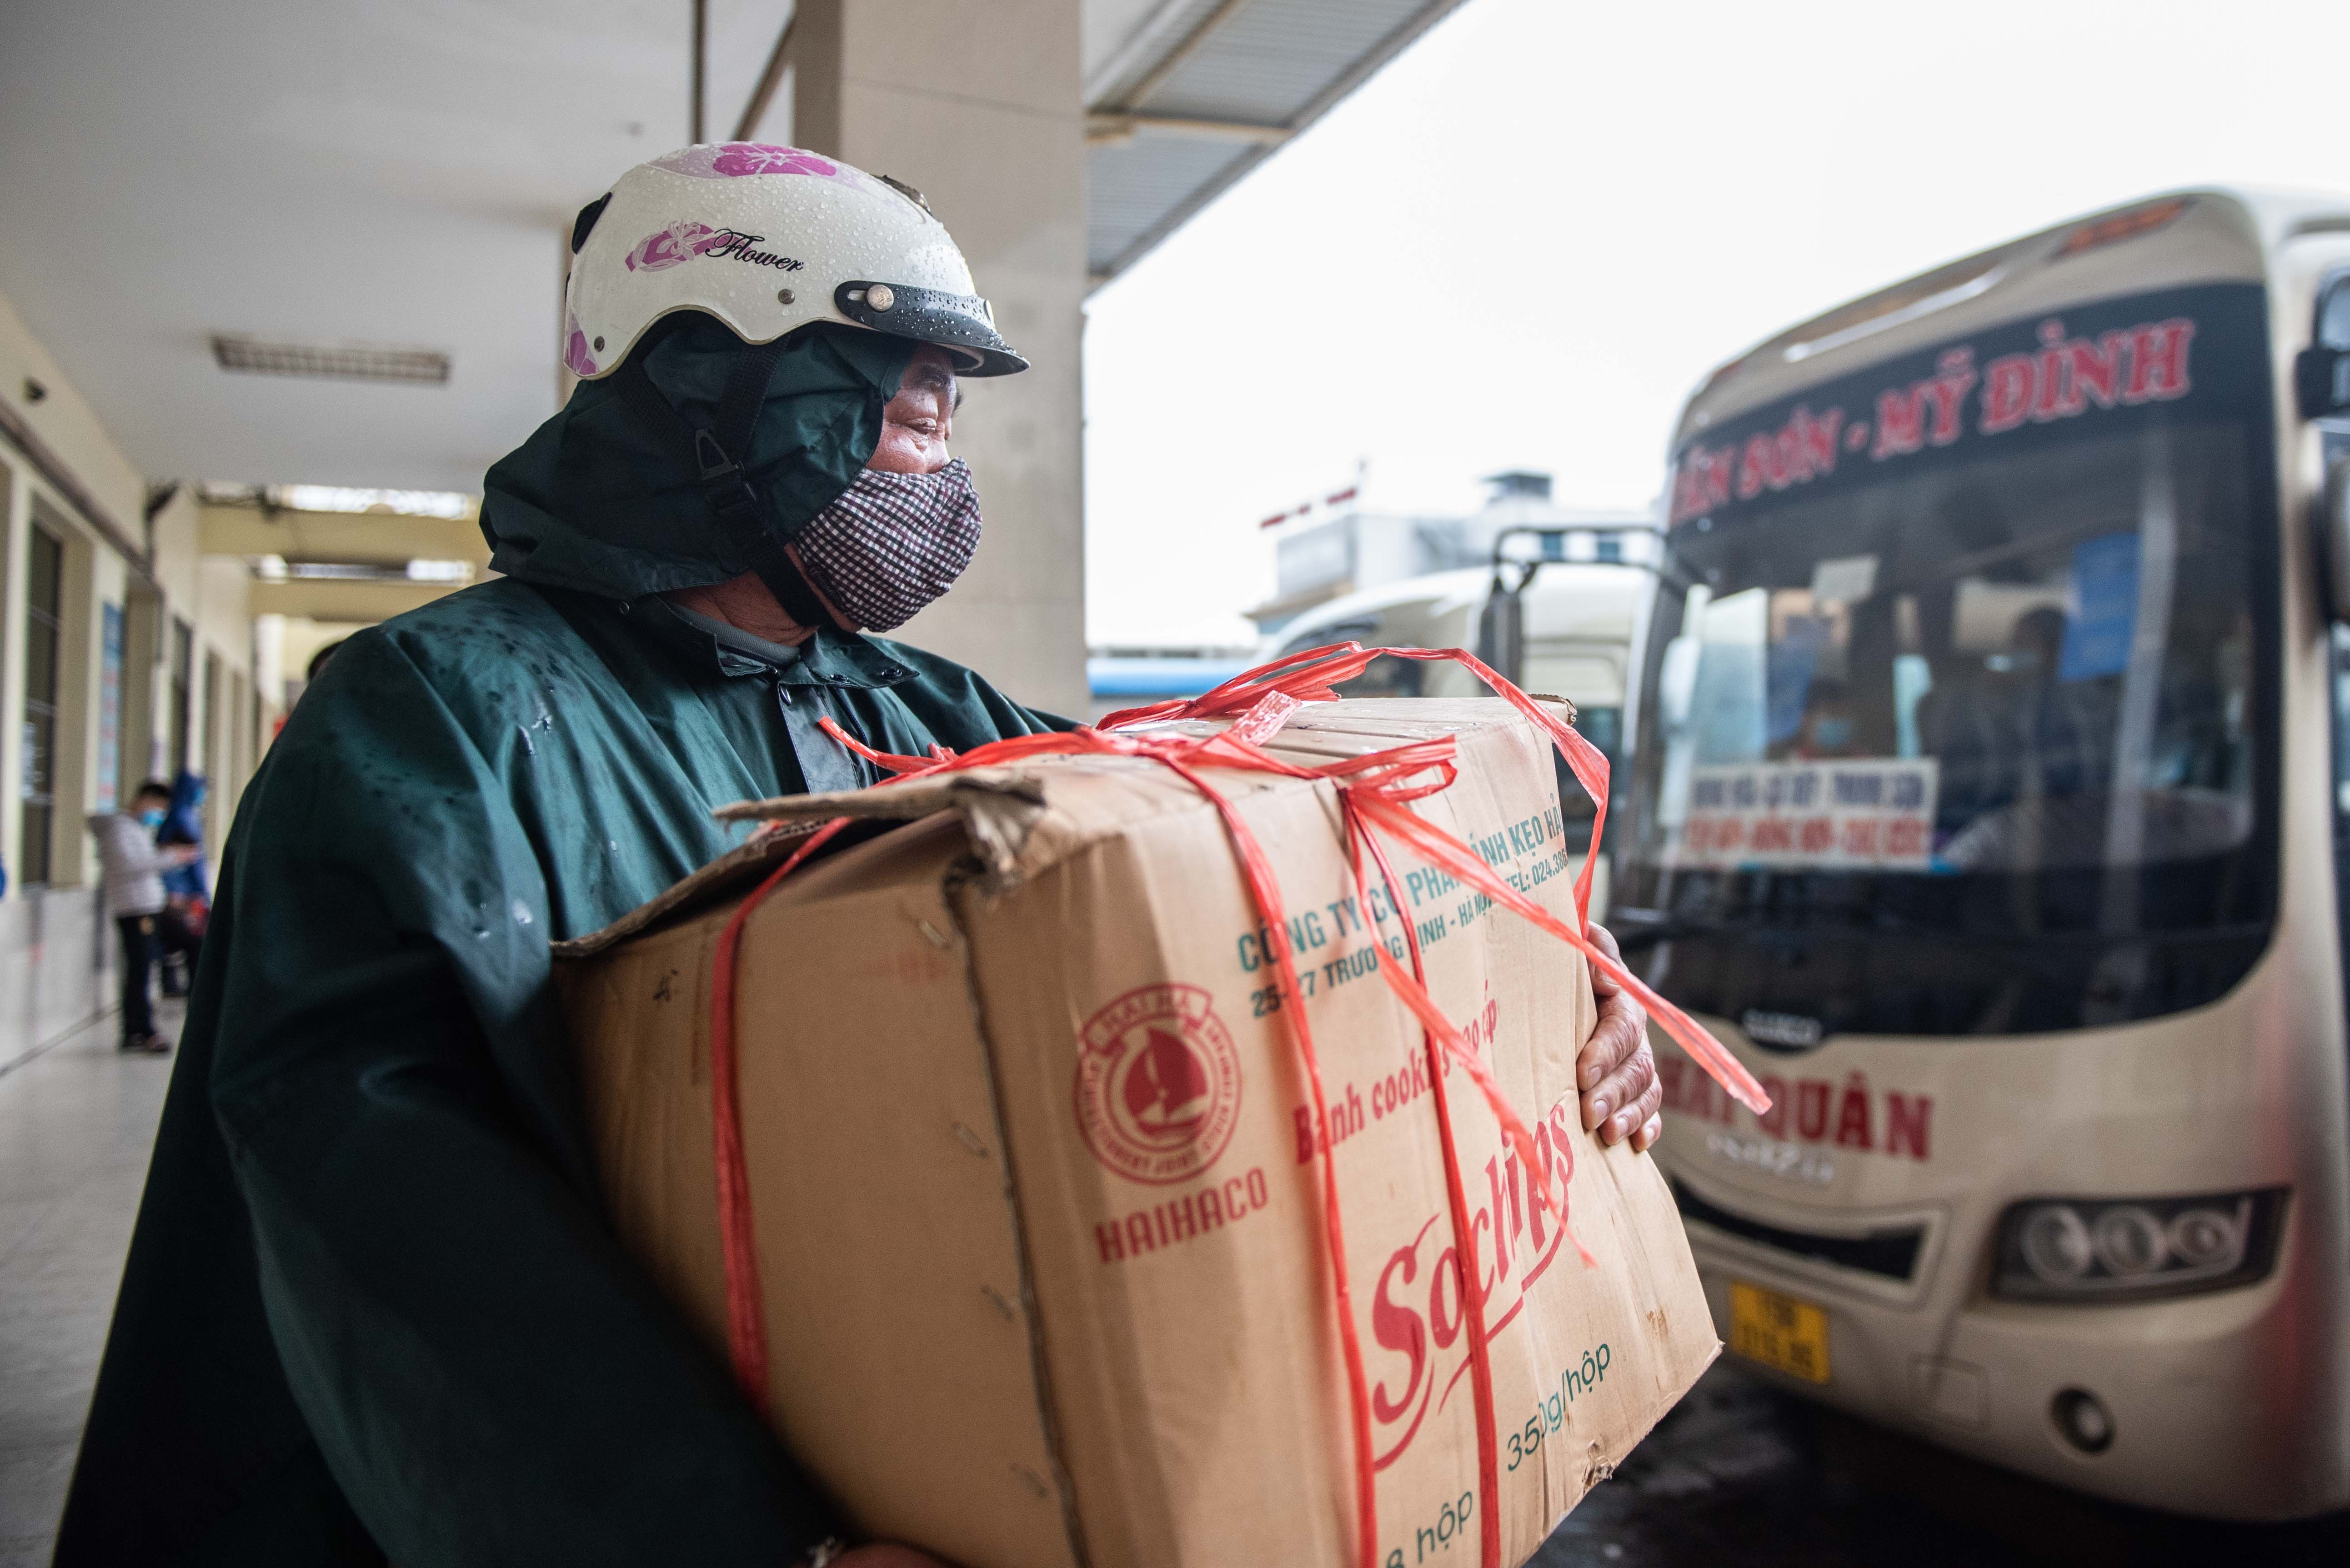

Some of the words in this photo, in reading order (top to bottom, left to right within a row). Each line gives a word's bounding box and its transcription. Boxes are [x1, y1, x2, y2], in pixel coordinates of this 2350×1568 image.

[705, 229, 804, 272] Flower
[1327, 896, 1361, 937] TY
[1508, 815, 1545, 857] KẸO
[1095, 1167, 1269, 1266] HAIHACO
